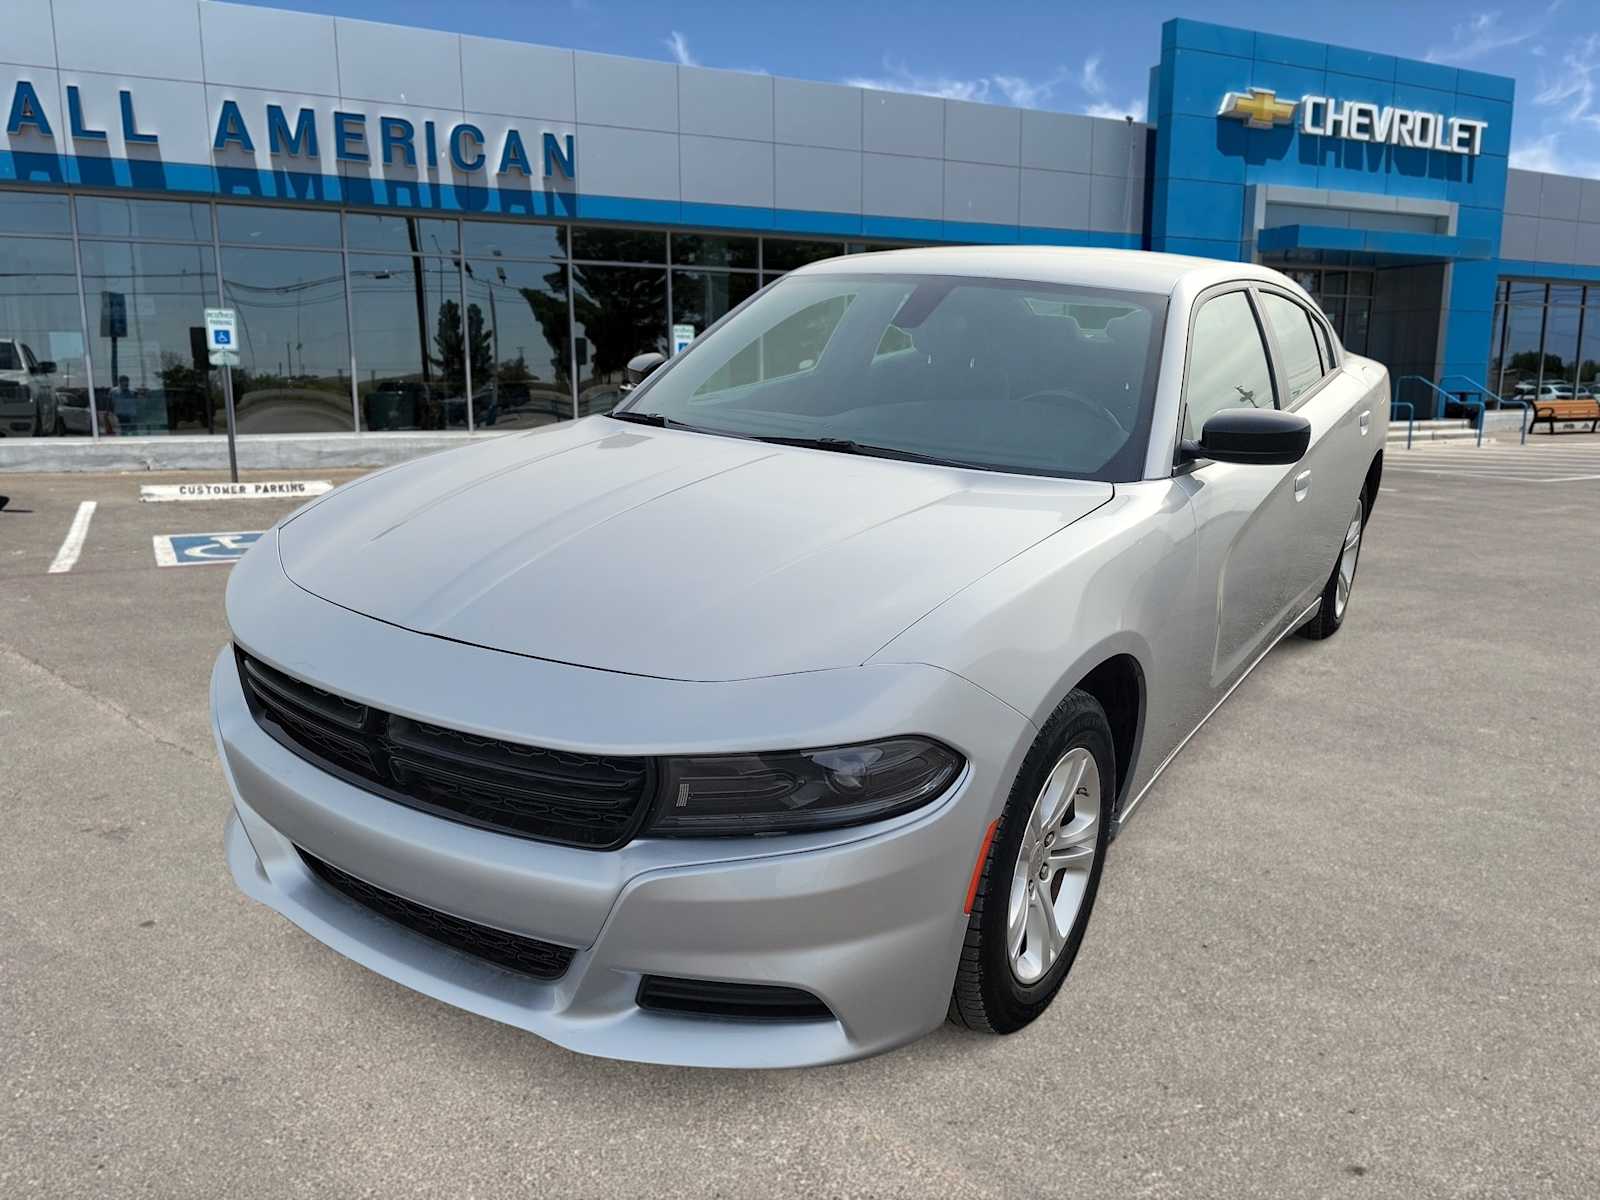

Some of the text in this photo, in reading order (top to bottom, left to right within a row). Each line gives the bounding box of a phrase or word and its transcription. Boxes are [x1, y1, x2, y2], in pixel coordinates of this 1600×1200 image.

[7, 80, 576, 179] ALL AMERICAN
[1302, 94, 1488, 155] CHEVROLET
[179, 483, 306, 495] CUSTOMER PARKING
